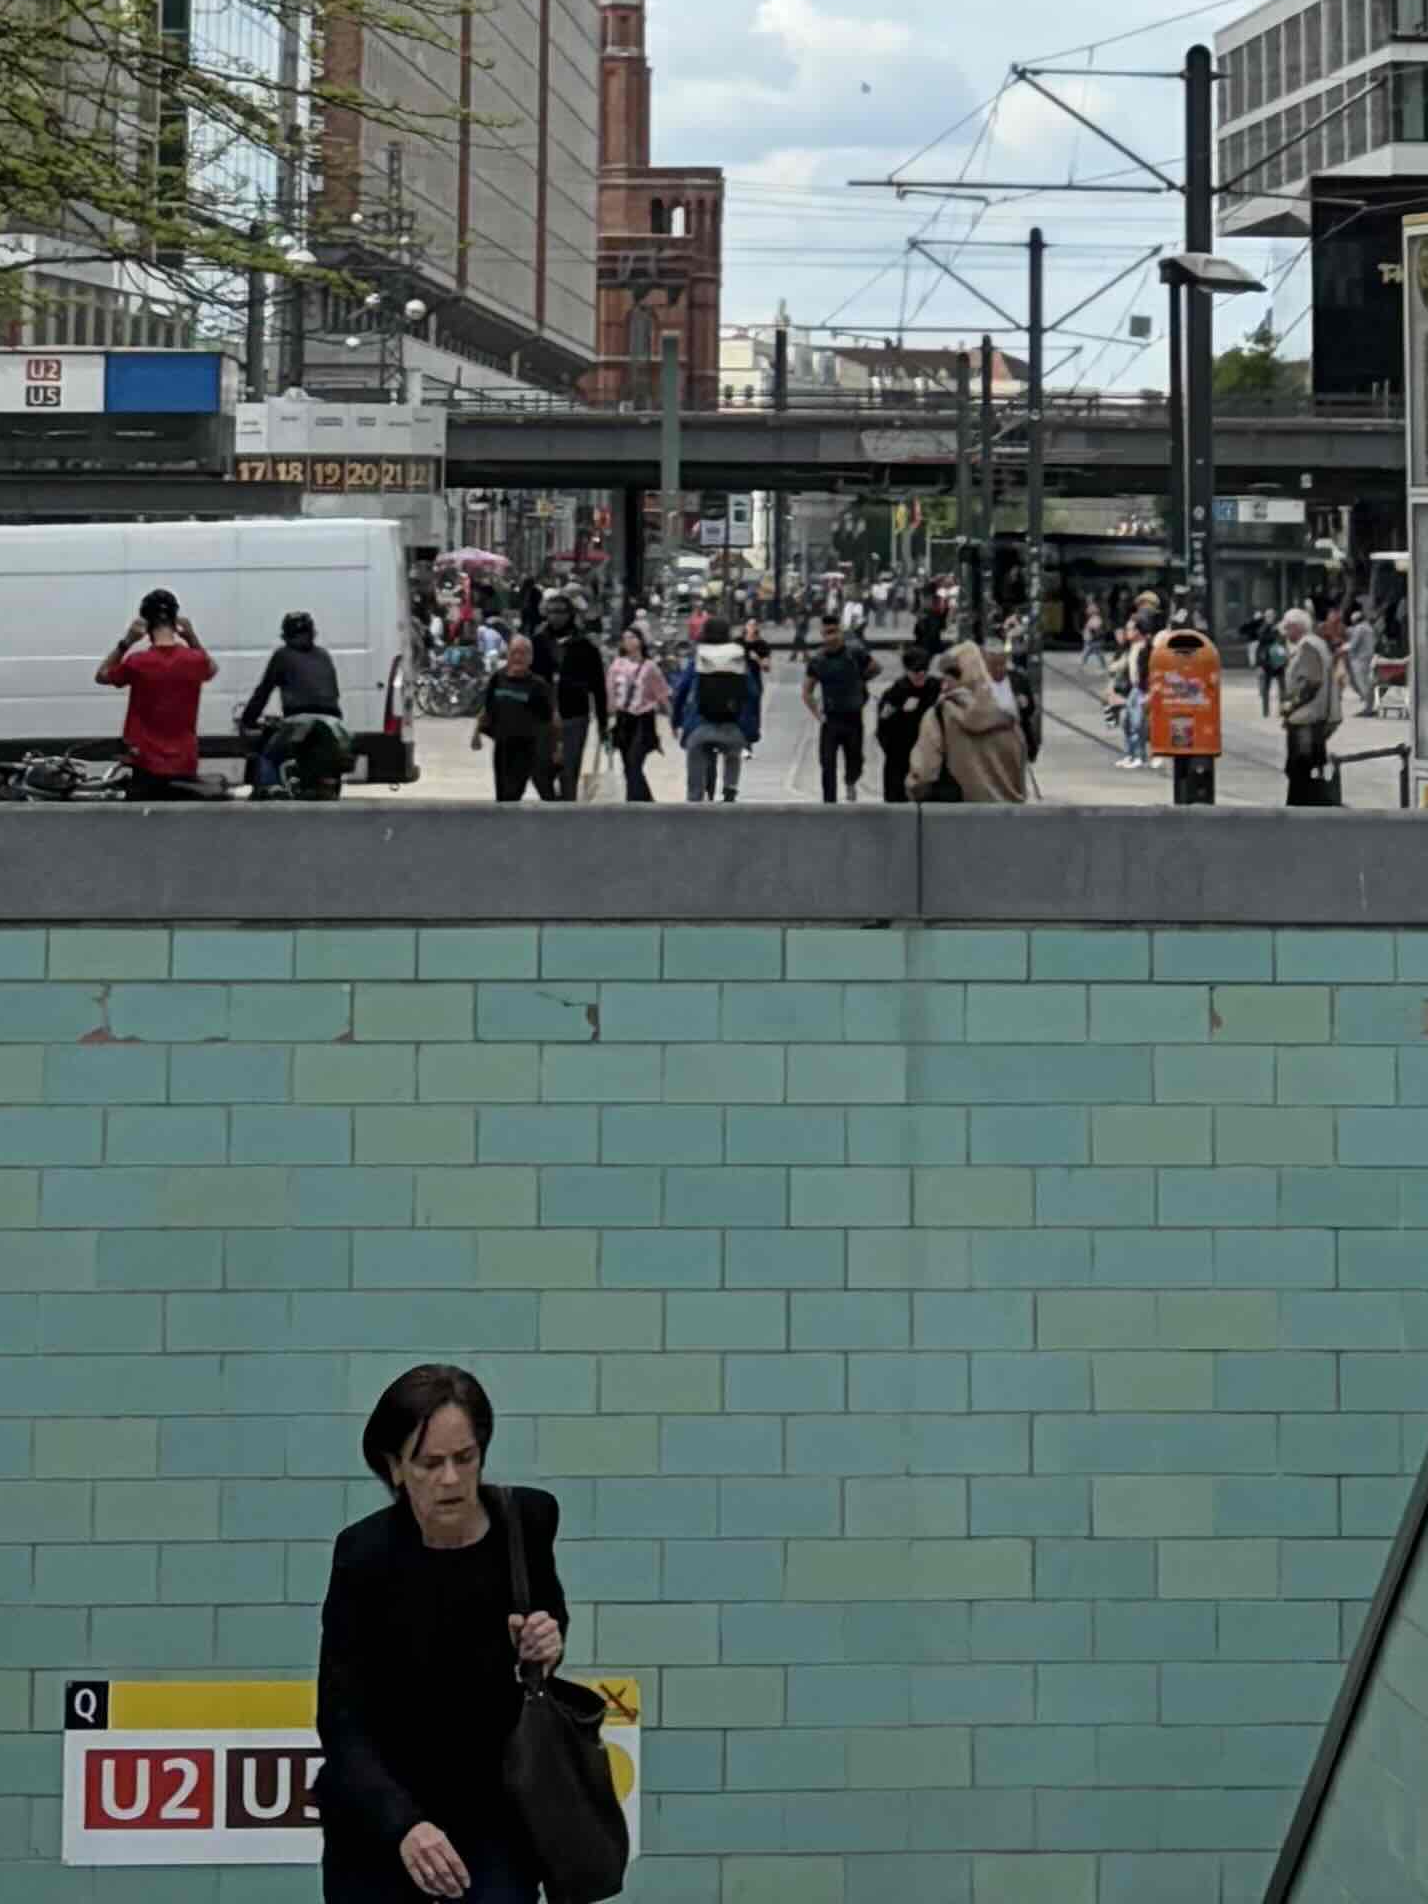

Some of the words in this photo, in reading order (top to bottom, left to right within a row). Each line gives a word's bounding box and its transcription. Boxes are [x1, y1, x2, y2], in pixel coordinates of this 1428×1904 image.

[30, 361, 58, 379] U2
[29, 387, 58, 405] U5
[238, 461, 266, 481] 17
[276, 461, 304, 482] 18
[314, 463, 341, 484] 19
[347, 462, 379, 485] 20
[383, 462, 405, 485] 21
[74, 1688, 99, 1723] Q
[100, 1756, 201, 1821] U2
